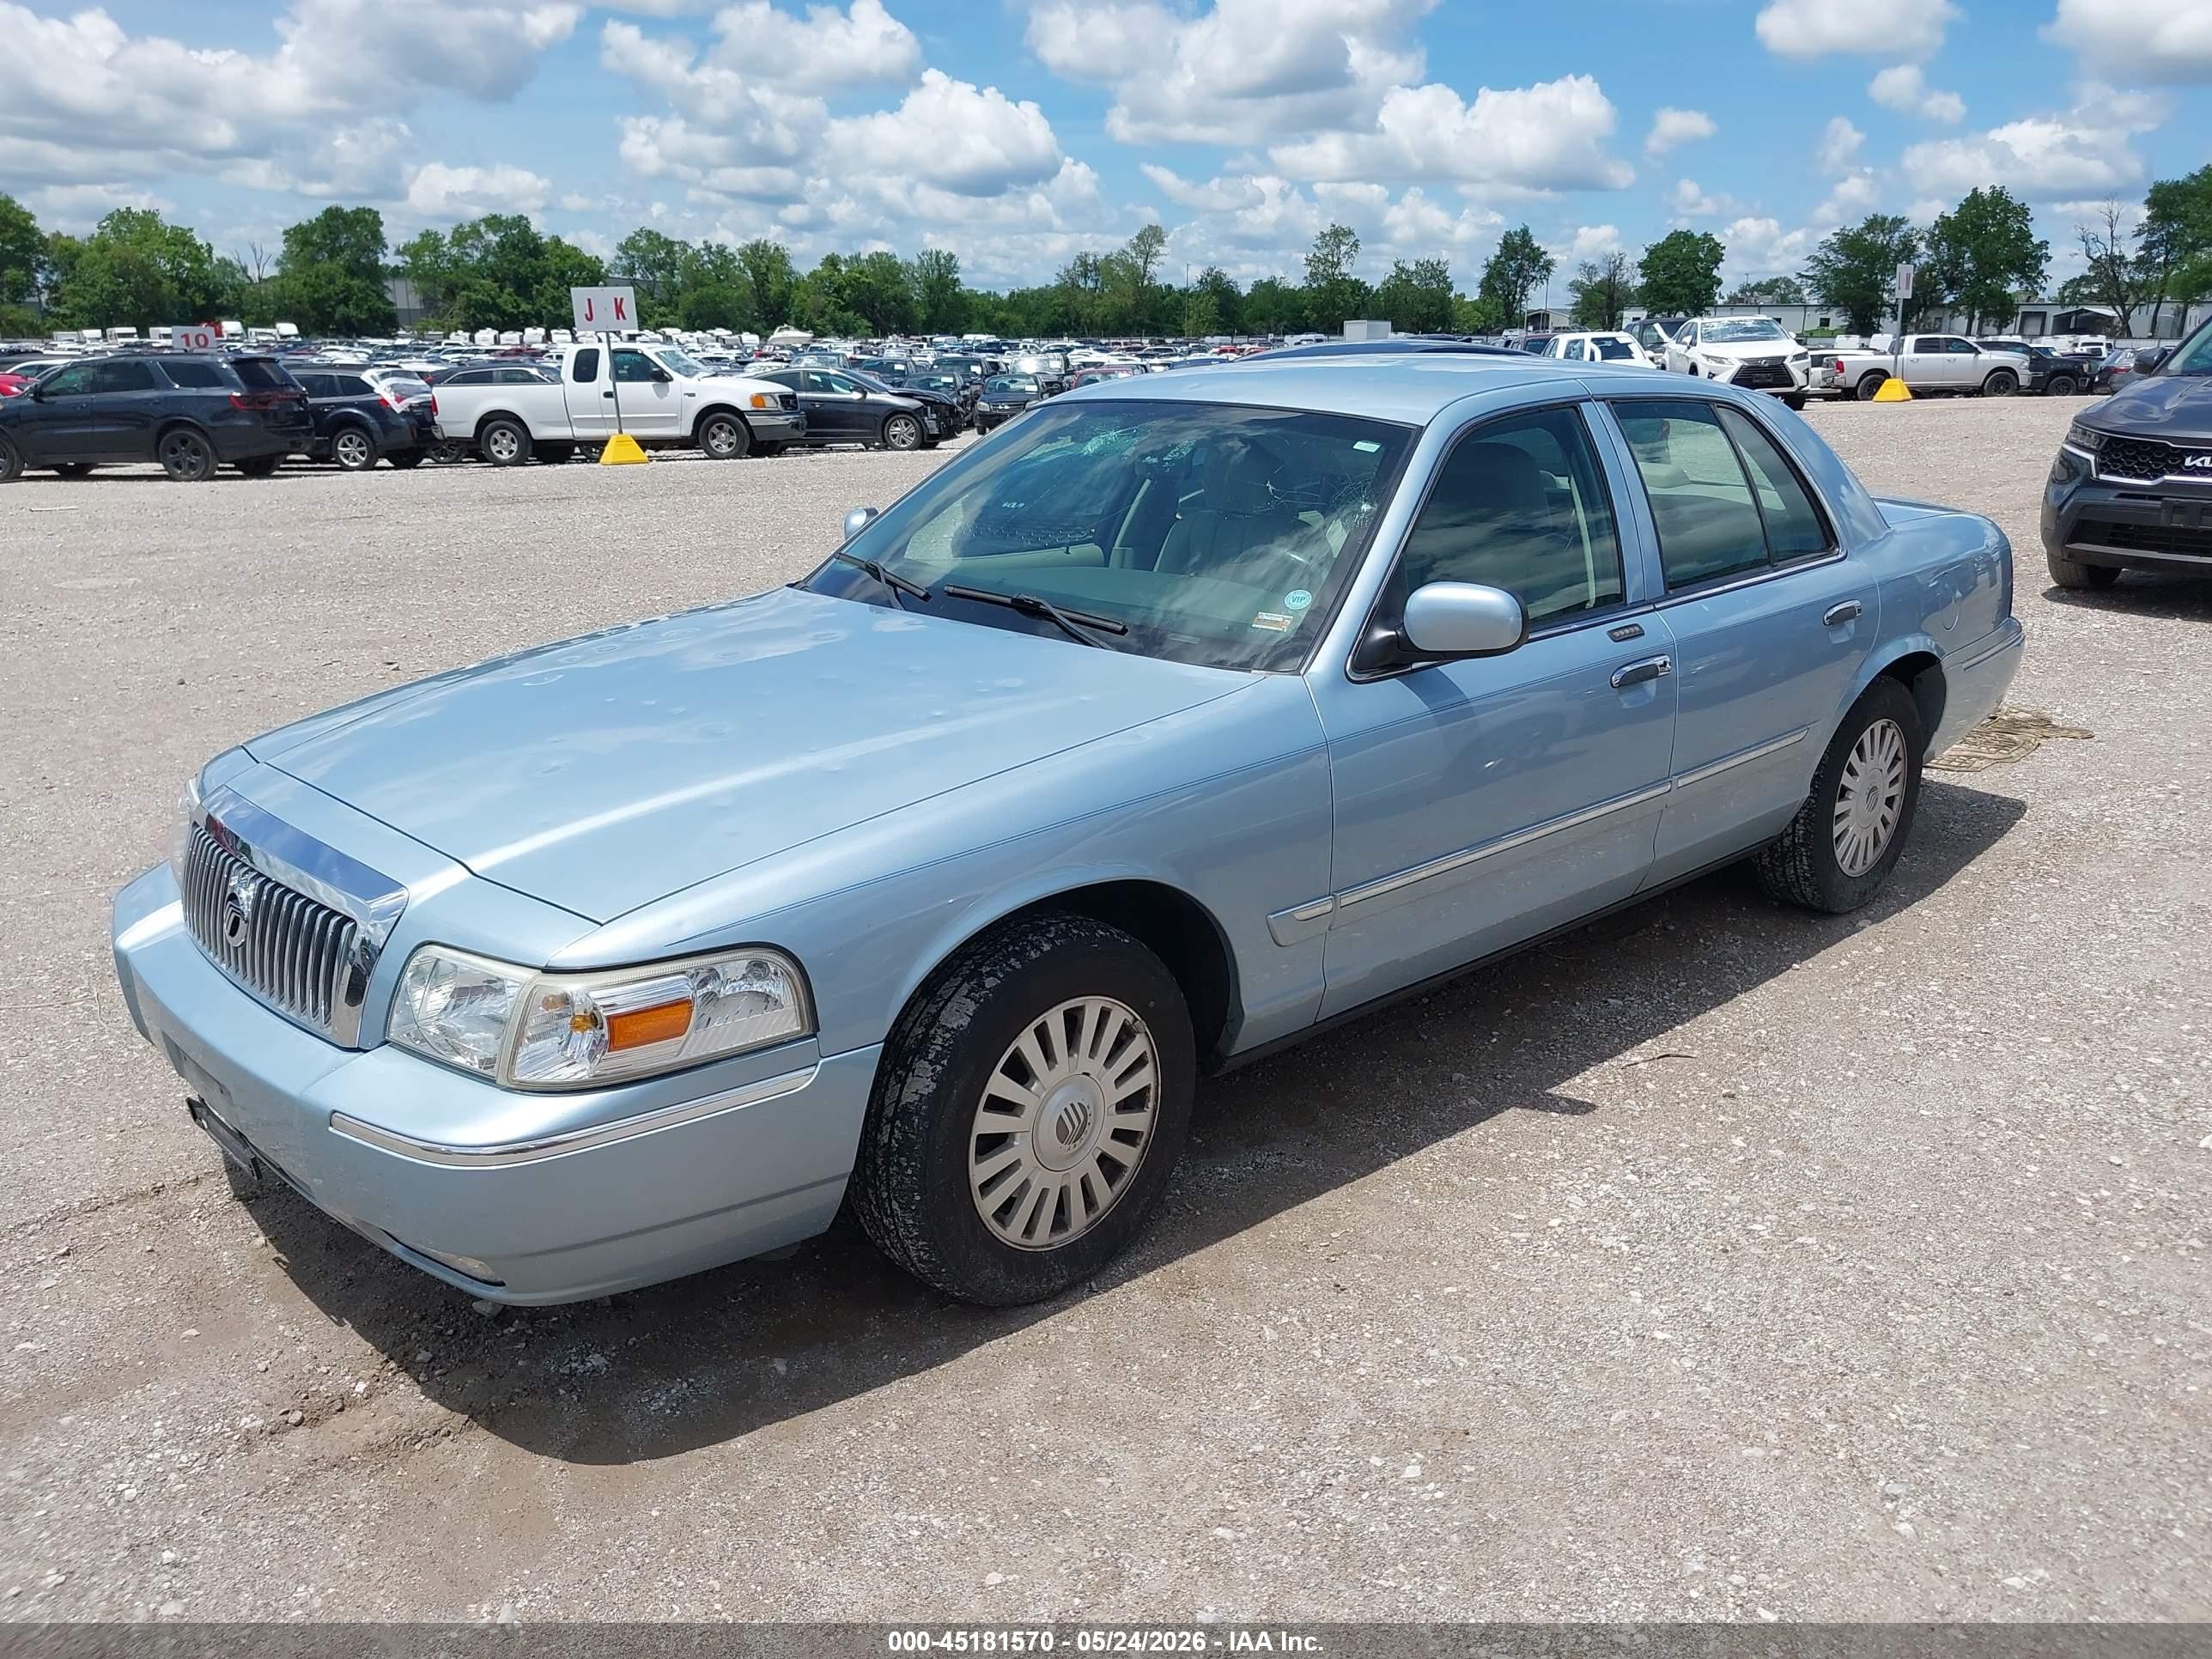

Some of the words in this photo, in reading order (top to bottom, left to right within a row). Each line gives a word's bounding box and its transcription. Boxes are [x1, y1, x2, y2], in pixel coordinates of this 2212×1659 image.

[585, 297, 594, 322] J
[613, 297, 627, 320] K
[180, 332, 210, 348] 10
